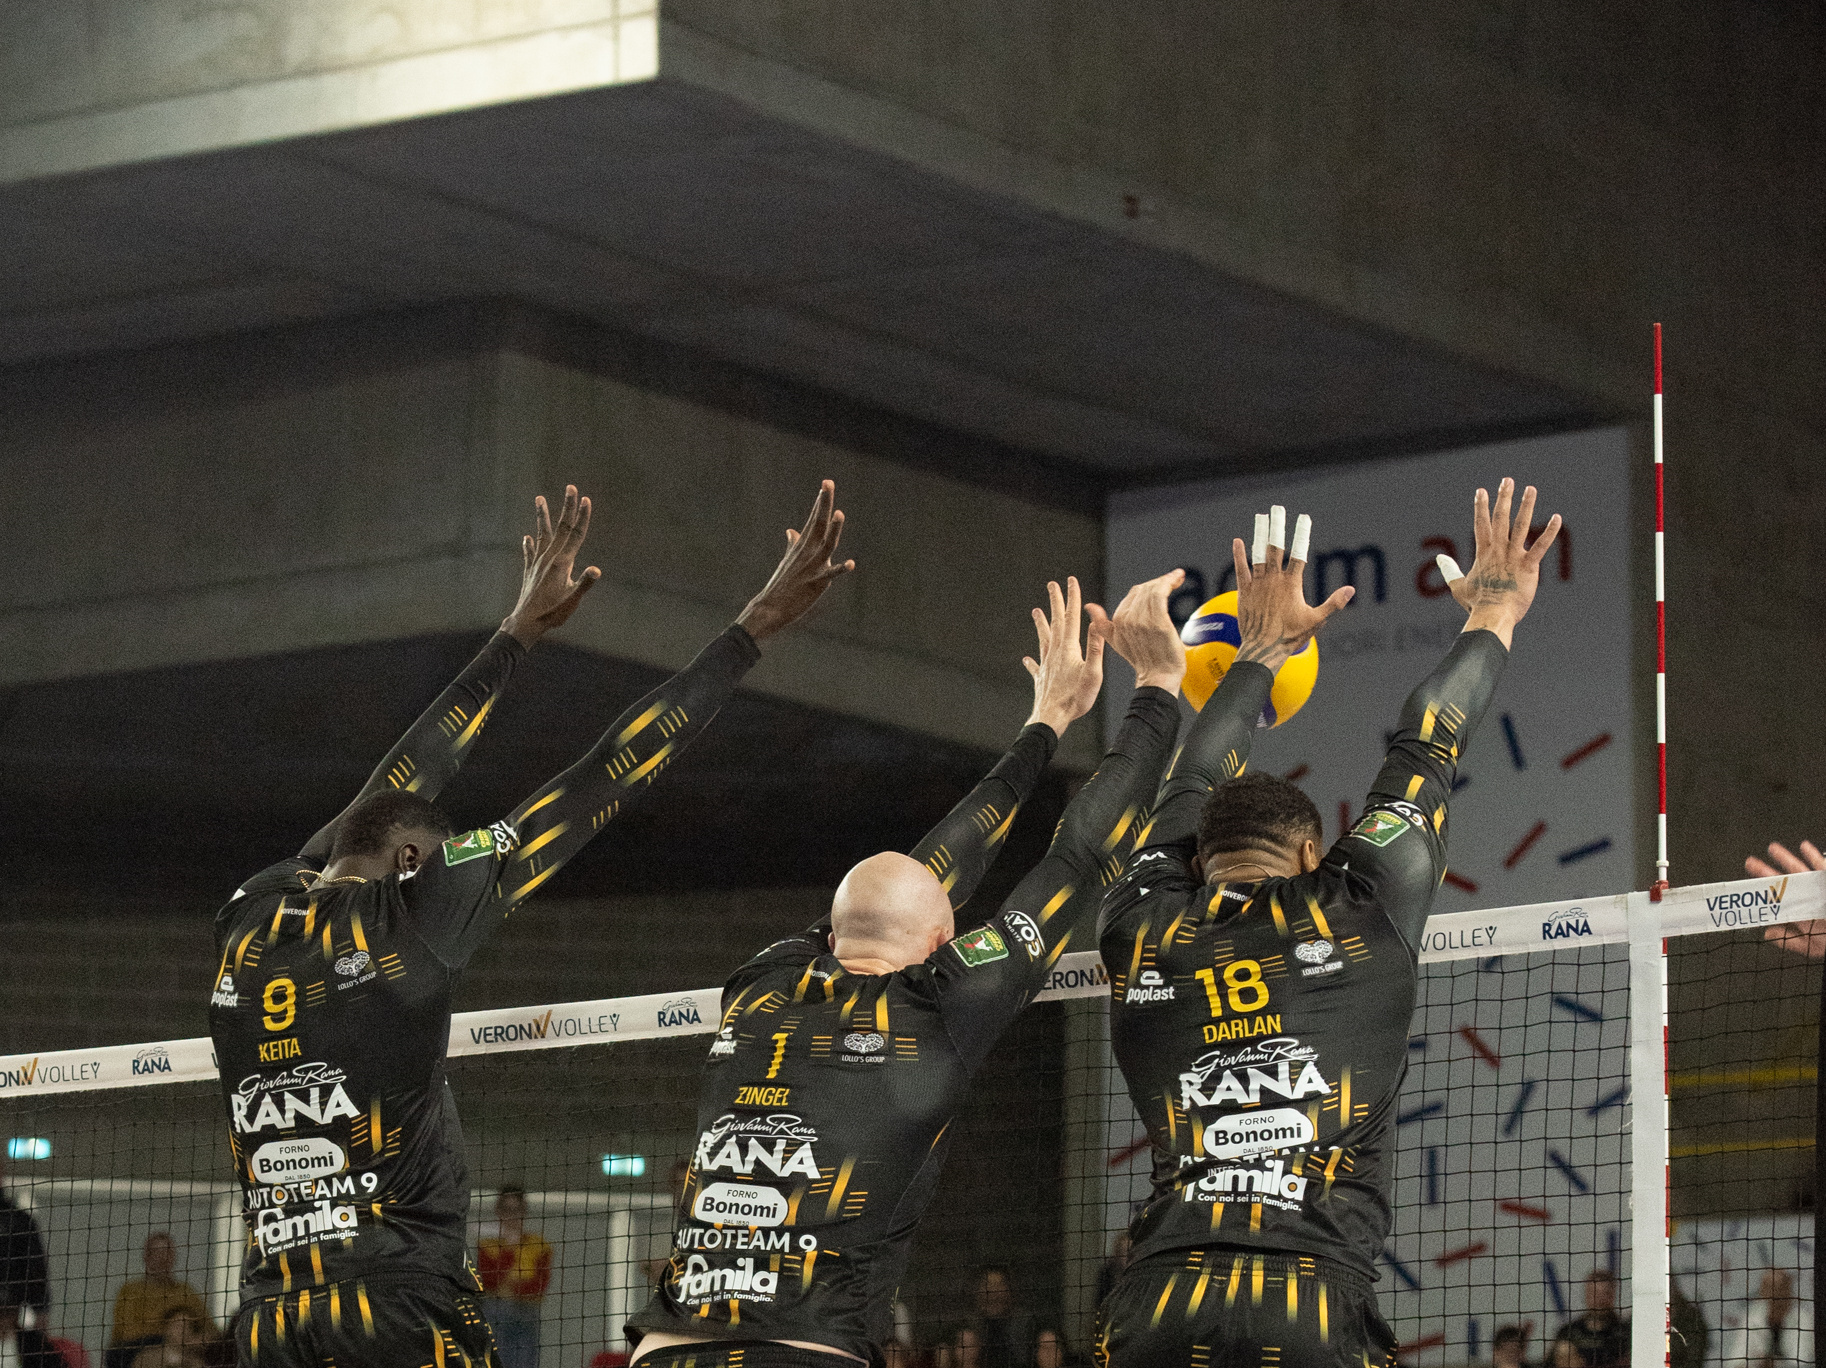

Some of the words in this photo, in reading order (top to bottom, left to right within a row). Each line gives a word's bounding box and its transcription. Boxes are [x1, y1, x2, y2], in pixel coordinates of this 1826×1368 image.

[1709, 905, 1780, 928] VOLLEY
[1420, 926, 1497, 952] VOLLEY
[1542, 917, 1592, 941] RANA
[358, 971, 378, 985] GROUP
[1324, 960, 1343, 973] GROUP
[211, 991, 239, 1008] poplast
[1126, 986, 1175, 1004] poplast
[1195, 960, 1270, 1018] 18
[262, 978, 297, 1032] 9
[551, 1014, 620, 1037] VOLLEY
[657, 1007, 702, 1028] RANA
[1203, 1014, 1282, 1044] DARLAN
[258, 1037, 302, 1062] KEITA
[765, 1032, 790, 1079] 1
[865, 1055, 885, 1063] GROUP
[1191, 1046, 1270, 1081] Giovanni
[1258, 1038, 1321, 1064] Rana
[37, 1061, 100, 1084] VOLLEY
[132, 1057, 172, 1075] RANA
[238, 1072, 302, 1106] Giovanni
[292, 1062, 348, 1086] Rana
[1179, 1061, 1333, 1111] RANA
[231, 1083, 361, 1133] RANA
[734, 1087, 791, 1106] ZINGEL
[711, 1114, 773, 1143] Giovanni
[766, 1114, 819, 1142] Rana
[1239, 1115, 1275, 1126] FORNO
[1214, 1123, 1303, 1147] Bonomi
[279, 1145, 310, 1155] FORNO
[694, 1131, 822, 1179] RANA
[259, 1151, 335, 1174] Bonomi
[247, 1175, 356, 1210] AUTOTEAM
[360, 1172, 378, 1193] 9
[726, 1188, 758, 1199] FORNO
[1197, 1193, 1217, 1203] Con
[1219, 1193, 1235, 1203] noi
[1236, 1194, 1249, 1203] sei
[1251, 1194, 1261, 1203] in
[1262, 1195, 1302, 1212] famiglia.
[701, 1196, 778, 1219] Bonomi
[254, 1200, 358, 1257] famila
[677, 1228, 790, 1252] AUTOTEAM
[799, 1234, 817, 1252] 9
[268, 1245, 282, 1255] Con
[283, 1240, 295, 1251] noi
[297, 1238, 309, 1248] sei
[310, 1235, 318, 1244] in
[319, 1230, 359, 1244] famiglia.
[676, 1254, 778, 1303] famila
[701, 1294, 712, 1303] noi
[723, 1291, 731, 1300] in
[733, 1291, 774, 1302] famiglia.
